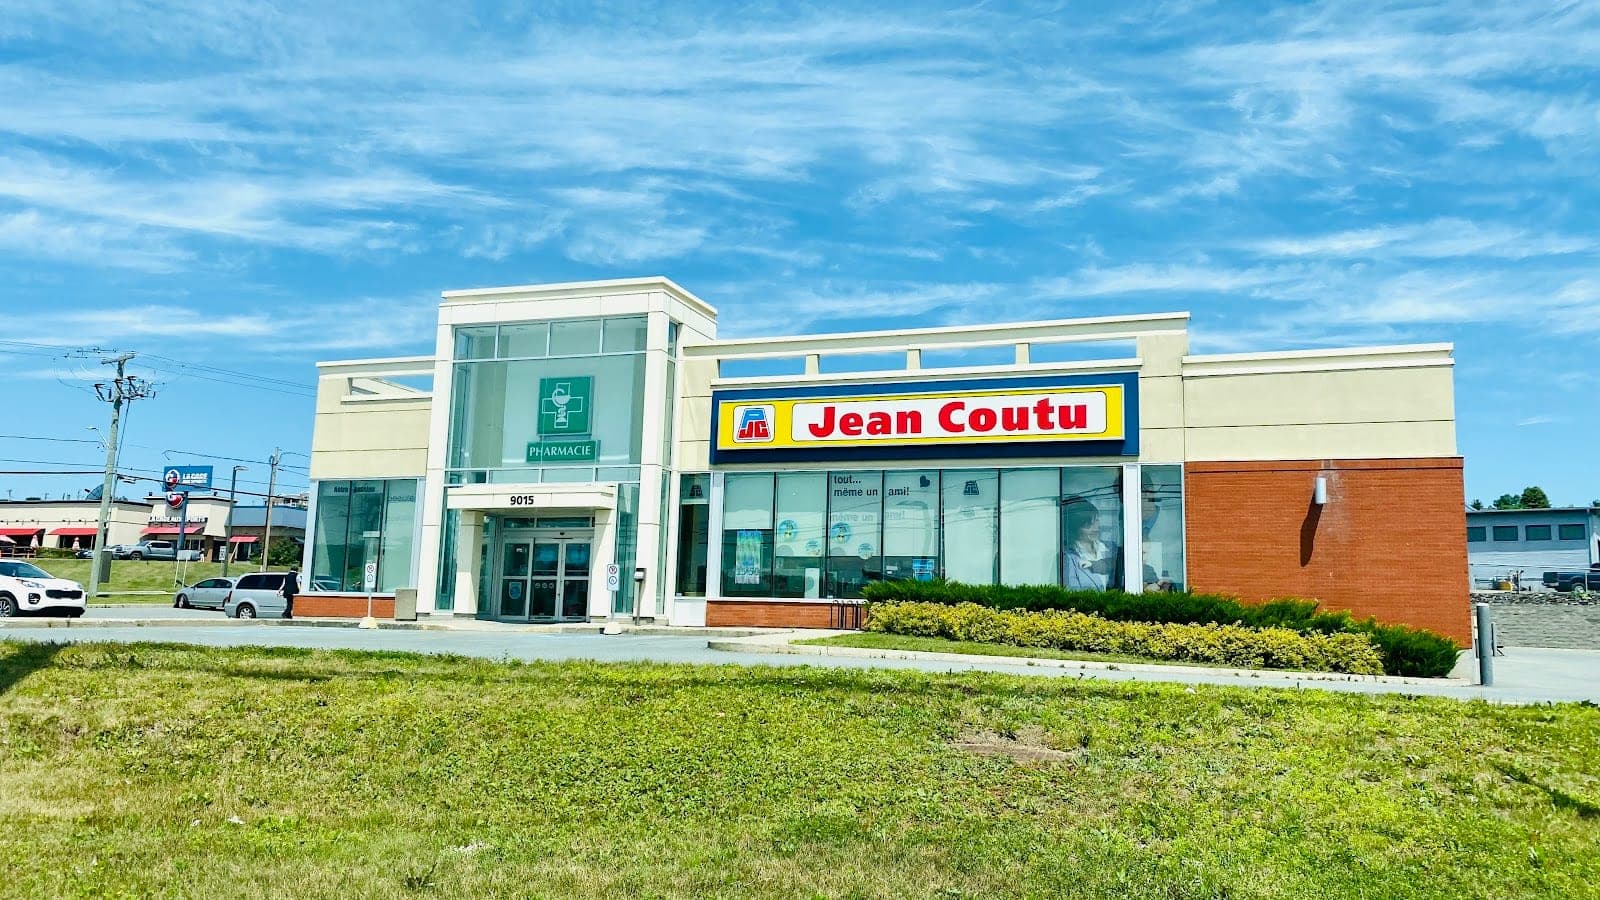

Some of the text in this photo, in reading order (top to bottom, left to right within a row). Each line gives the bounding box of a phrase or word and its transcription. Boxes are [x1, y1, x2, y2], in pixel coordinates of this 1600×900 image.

[808, 398, 1087, 438] Jean Coutu
[529, 445, 592, 457] PHARMACIE
[833, 475, 862, 484] tout...
[866, 488, 878, 496] un
[888, 487, 910, 496] ami!
[510, 495, 534, 505] 9015
